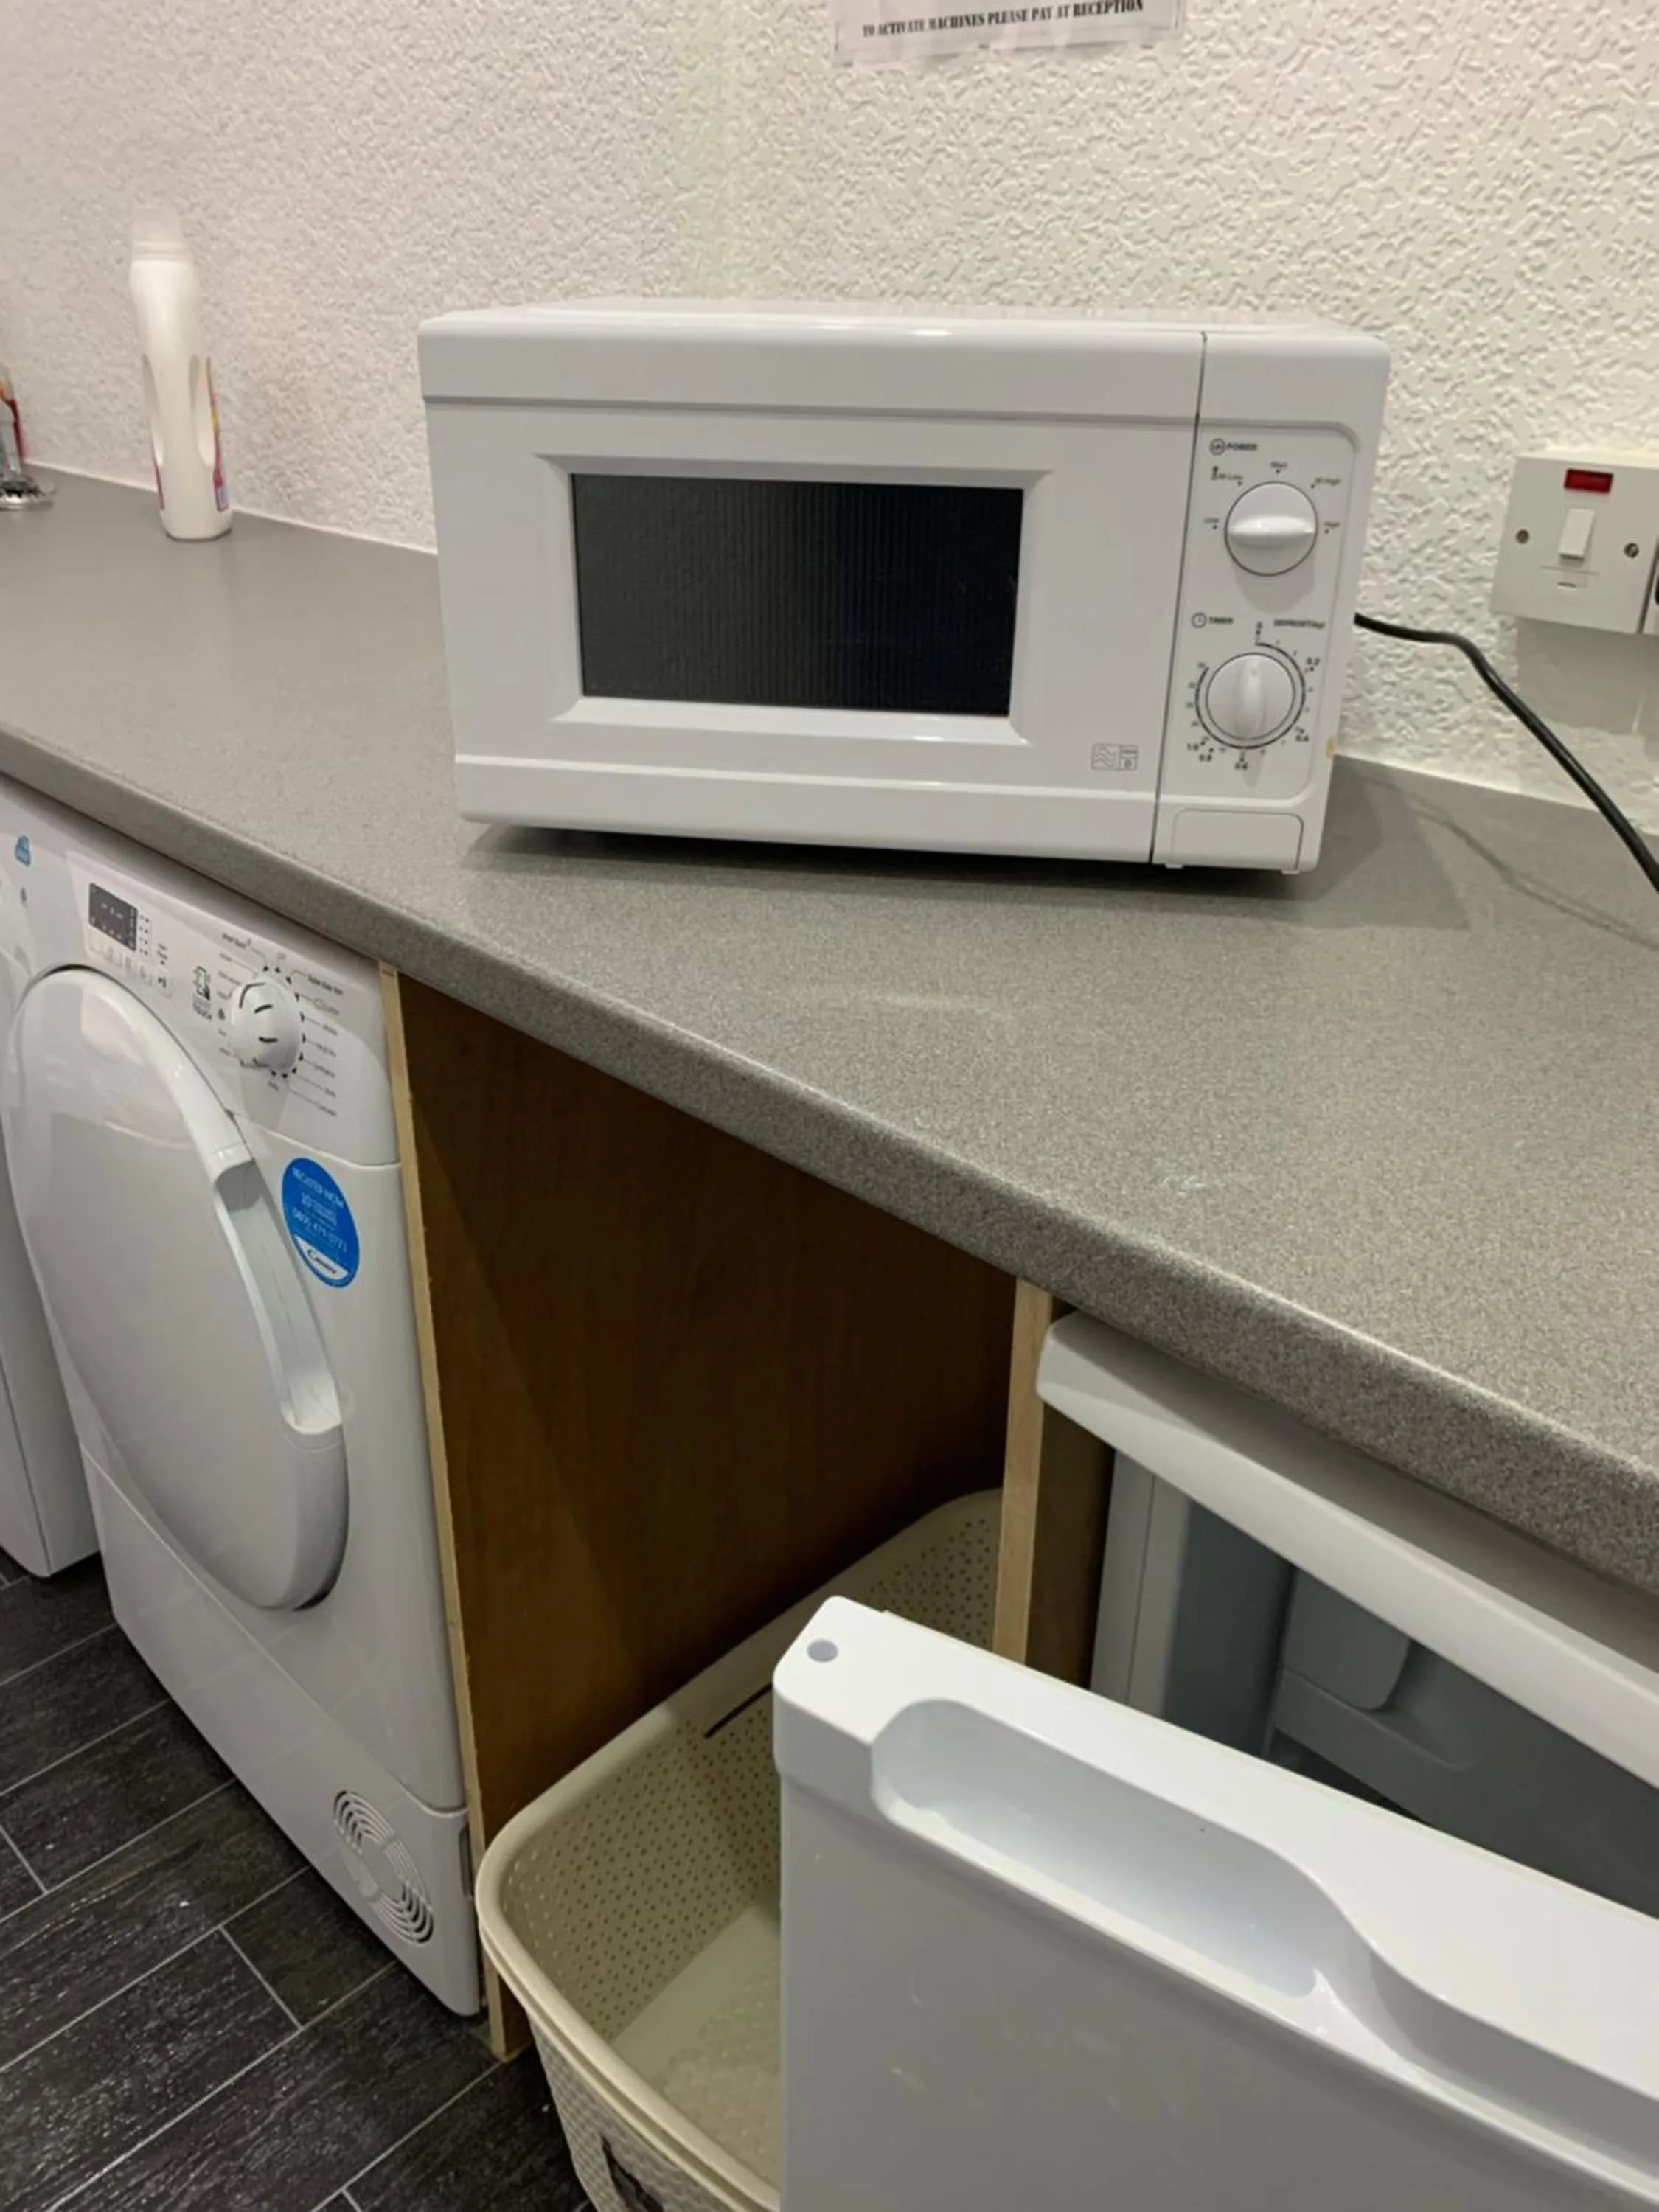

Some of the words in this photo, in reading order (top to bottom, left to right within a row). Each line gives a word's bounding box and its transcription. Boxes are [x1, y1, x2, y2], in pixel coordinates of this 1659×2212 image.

[863, 24, 875, 37] TO
[878, 18, 925, 36] ACTIVATE
[928, 13, 985, 31] MACHINES
[988, 8, 1029, 25] PLEASE
[1032, 6, 1054, 21] PAY
[1057, 4, 1070, 19] AT
[1072, 0, 1144, 18] RECEPTION
